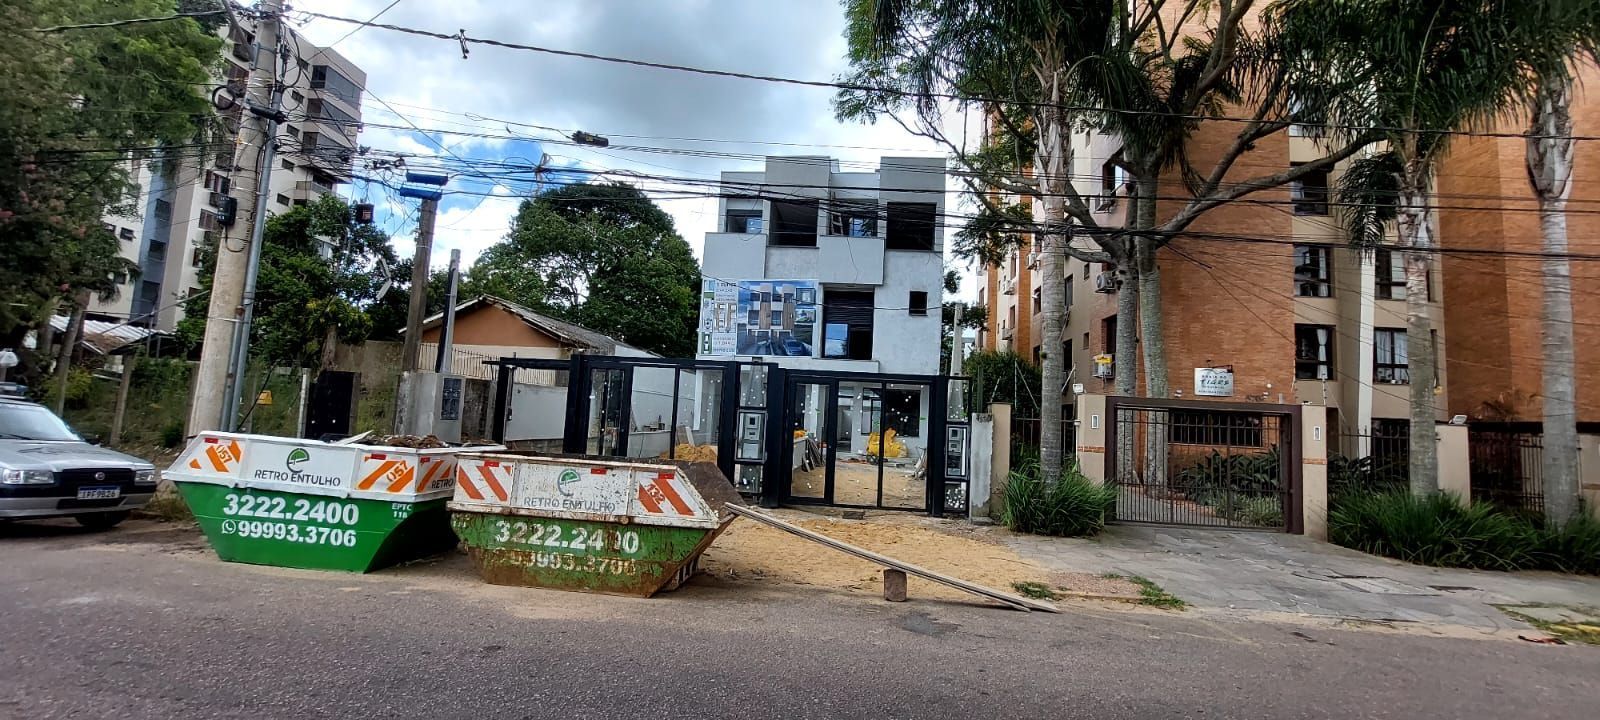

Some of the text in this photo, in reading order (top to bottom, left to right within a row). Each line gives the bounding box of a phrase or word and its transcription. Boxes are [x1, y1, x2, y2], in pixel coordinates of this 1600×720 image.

[216, 444, 233, 464] 057
[254, 469, 341, 487] RETRO ENTULHO
[386, 460, 408, 482] 057
[431, 478, 454, 489] RETRO
[646, 483, 666, 504] 132
[223, 493, 360, 526] 3222.2400
[391, 502, 412, 511] EPTC
[524, 496, 617, 513] RETRO ENTULHO
[238, 520, 357, 547] 99993.3706
[495, 520, 639, 554] 3222.2400
